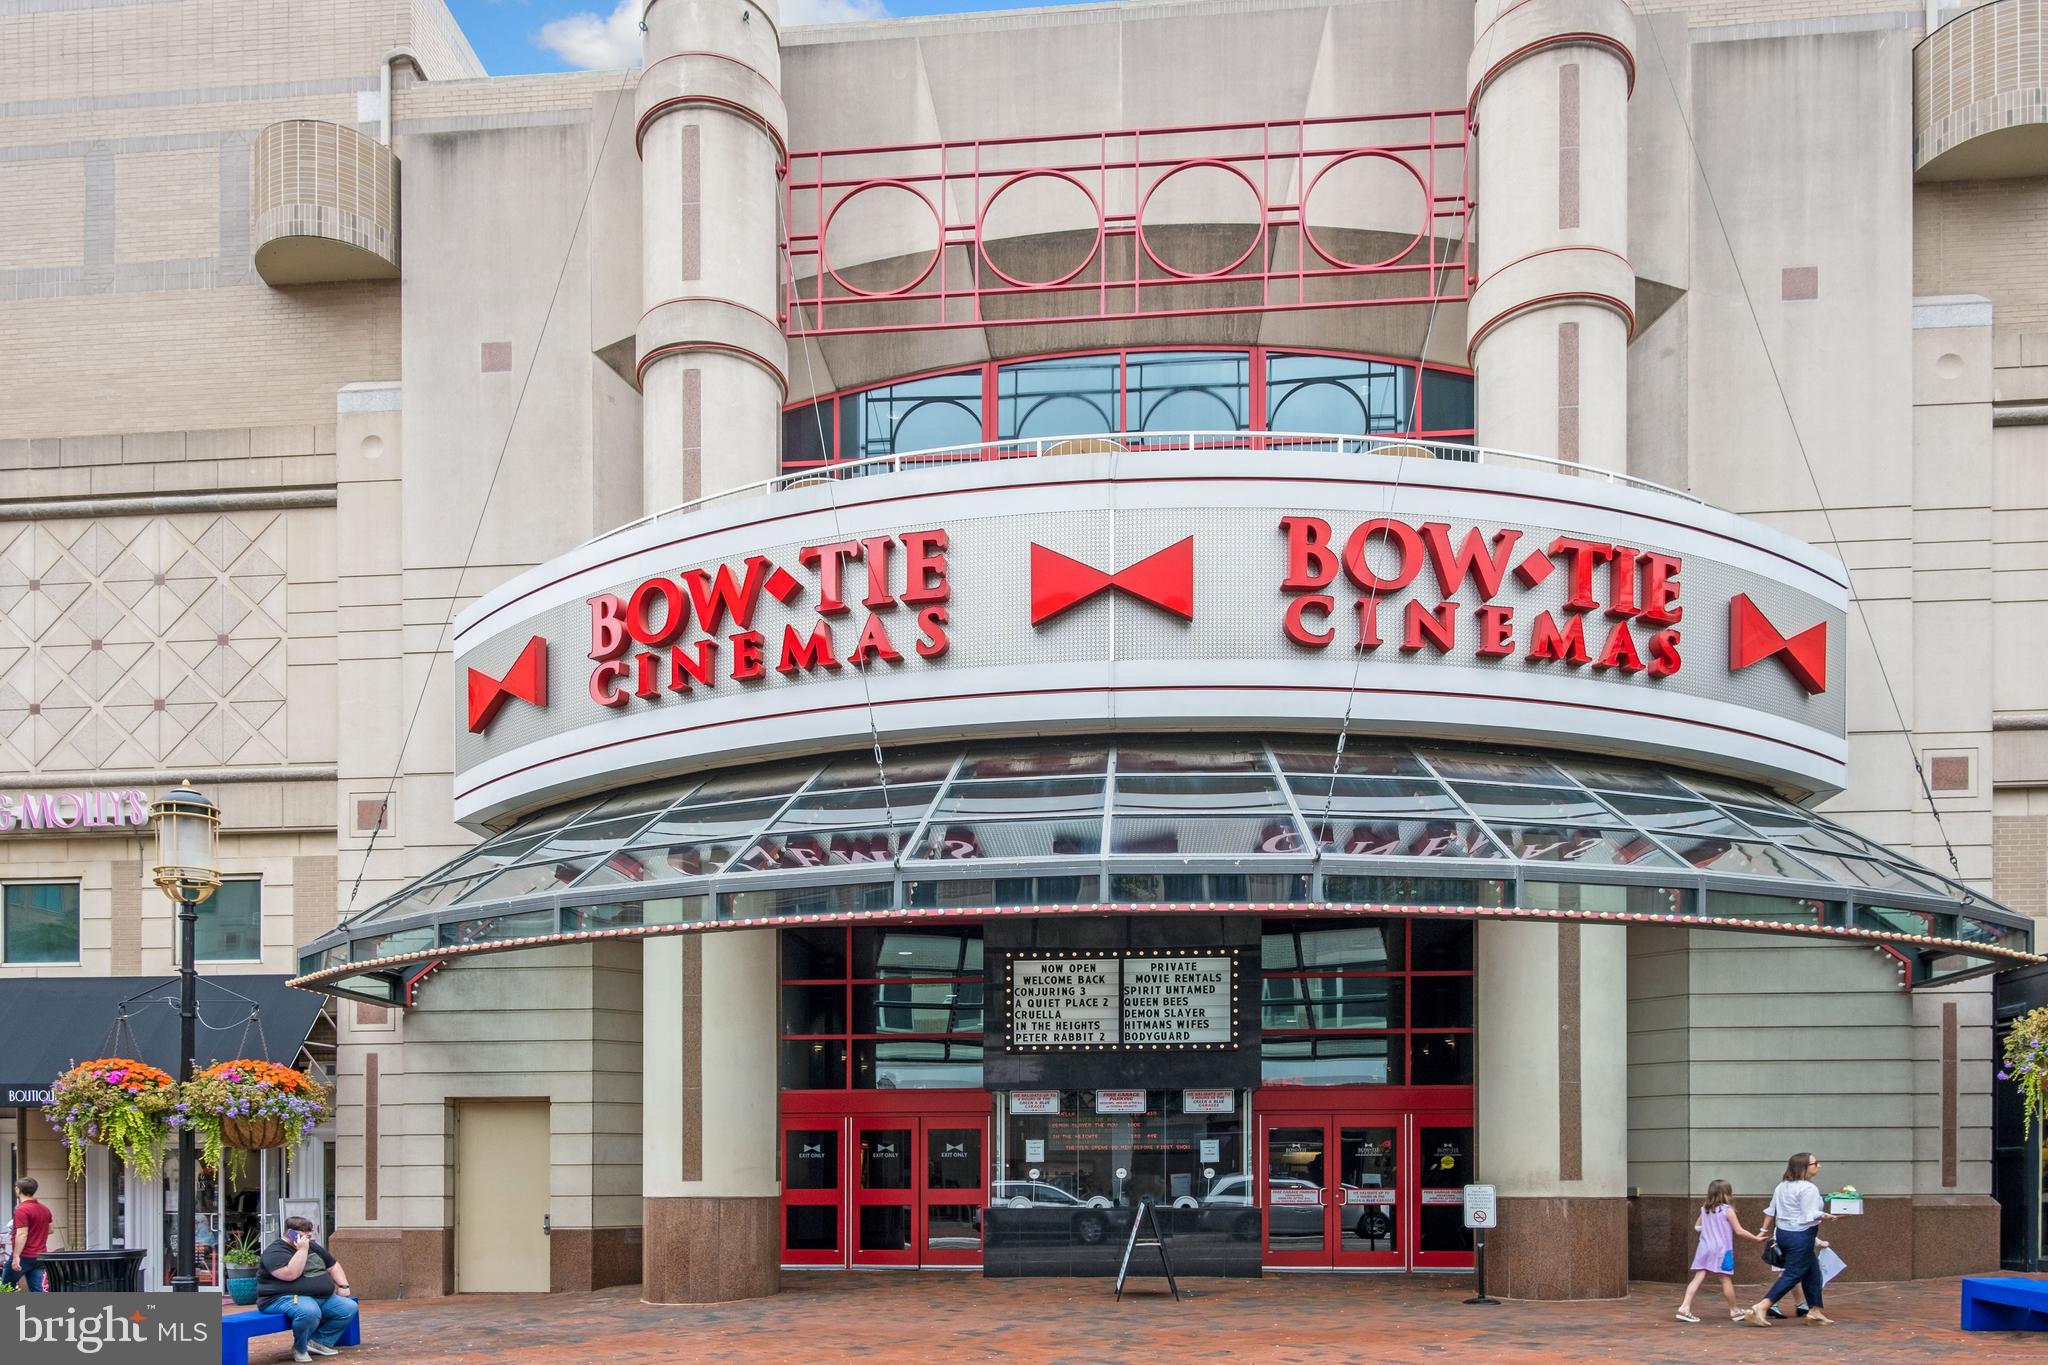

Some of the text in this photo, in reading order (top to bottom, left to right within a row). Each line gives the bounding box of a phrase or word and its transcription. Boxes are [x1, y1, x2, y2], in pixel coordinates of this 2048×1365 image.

[1283, 594, 1682, 678] CINEMAS
[589, 605, 951, 709] CINEMAS
[21, 789, 149, 830] MOLLY'S
[1041, 963, 1096, 973] NOW OPEN
[1151, 962, 1197, 972] PRIVATE
[1023, 975, 1105, 985] WELCOME BACK
[1136, 973, 1222, 983] MOVIE RENTALS
[1014, 987, 1086, 996] CONJURING 3
[1124, 985, 1216, 995] SPIRIT UNTAMED
[1016, 998, 1108, 1008] A QUIET PLACE 2
[1124, 997, 1188, 1006] QUEEN BEES
[1014, 1010, 1061, 1020] CRUELLA
[1124, 1008, 1205, 1018] DEMON SLAYER
[1016, 1021, 1100, 1030] IN THE HEIGHTS
[1124, 1020, 1210, 1030] HITMANS WIFES
[1016, 1032, 1105, 1042] PETER RABBIT 2
[1124, 1032, 1190, 1041] BODYGUARD
[9, 1090, 56, 1102] BOUTIQU
